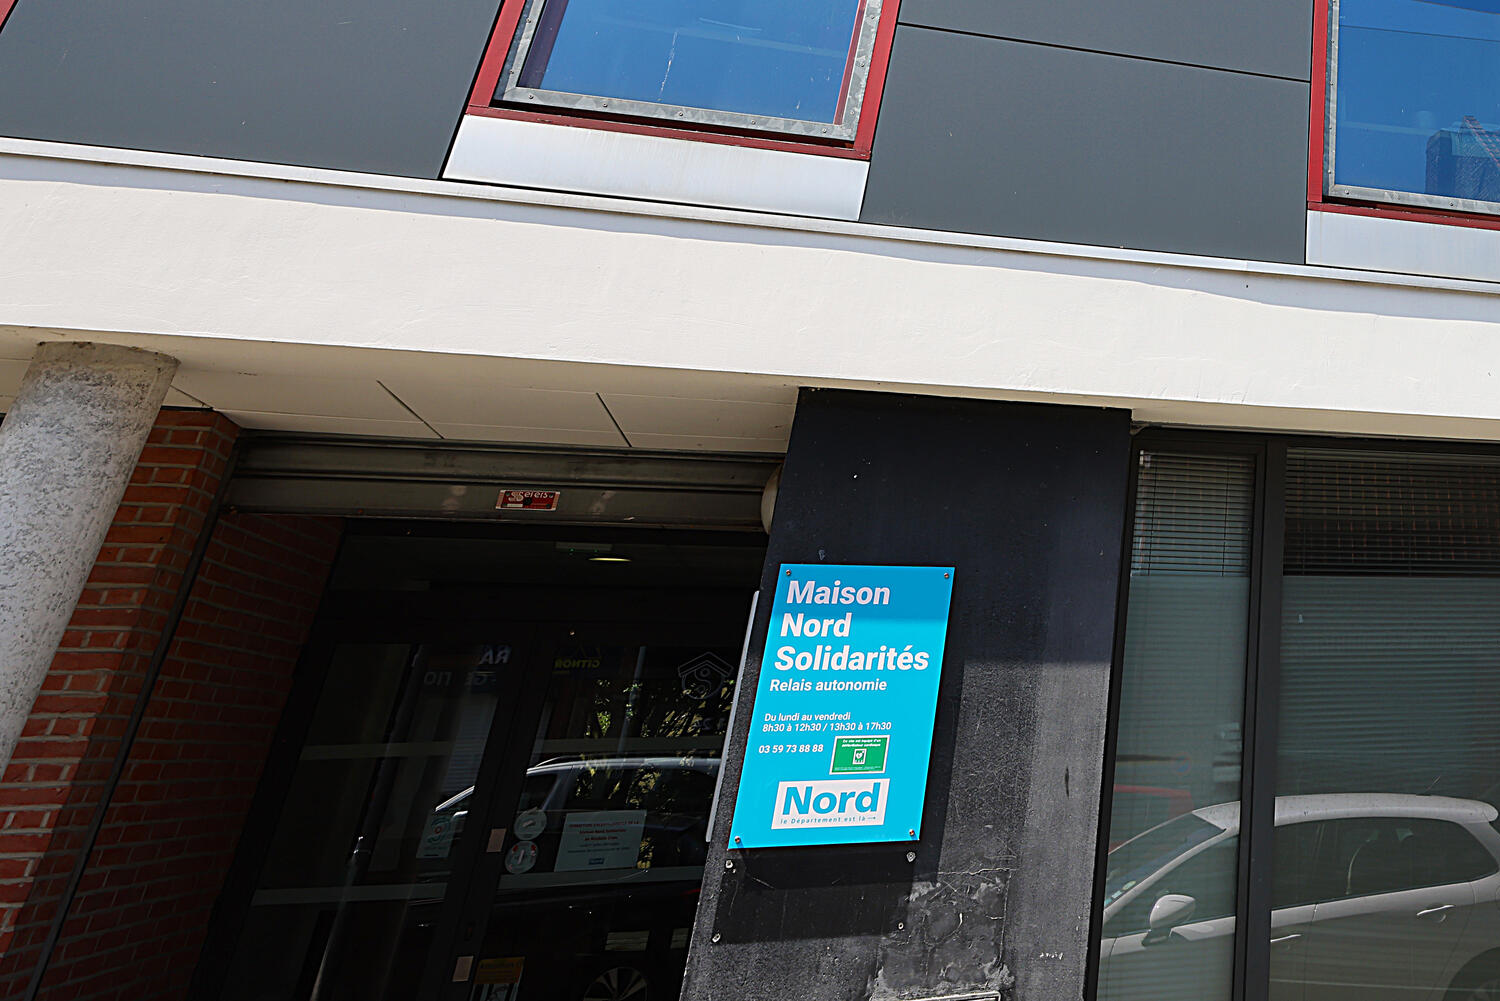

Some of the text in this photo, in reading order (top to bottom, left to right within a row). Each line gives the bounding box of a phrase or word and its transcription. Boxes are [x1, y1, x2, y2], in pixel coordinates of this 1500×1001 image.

[786, 580, 890, 605] Maison
[780, 612, 852, 637] Nord
[774, 644, 929, 671] Solidarités
[769, 678, 887, 692] Relais autonomie
[764, 713, 777, 722] Du
[778, 712, 800, 722] lundi
[814, 712, 851, 721] vendredi
[762, 723, 785, 732] 8h30
[786, 723, 794, 732] à
[794, 723, 822, 732] 12h30
[829, 722, 857, 732] 13h30
[858, 722, 865, 731] à
[866, 722, 892, 731] 17h30
[758, 744, 824, 754] 03 59 73 88 88
[782, 782, 881, 816] Nord
[790, 817, 842, 825] Département
